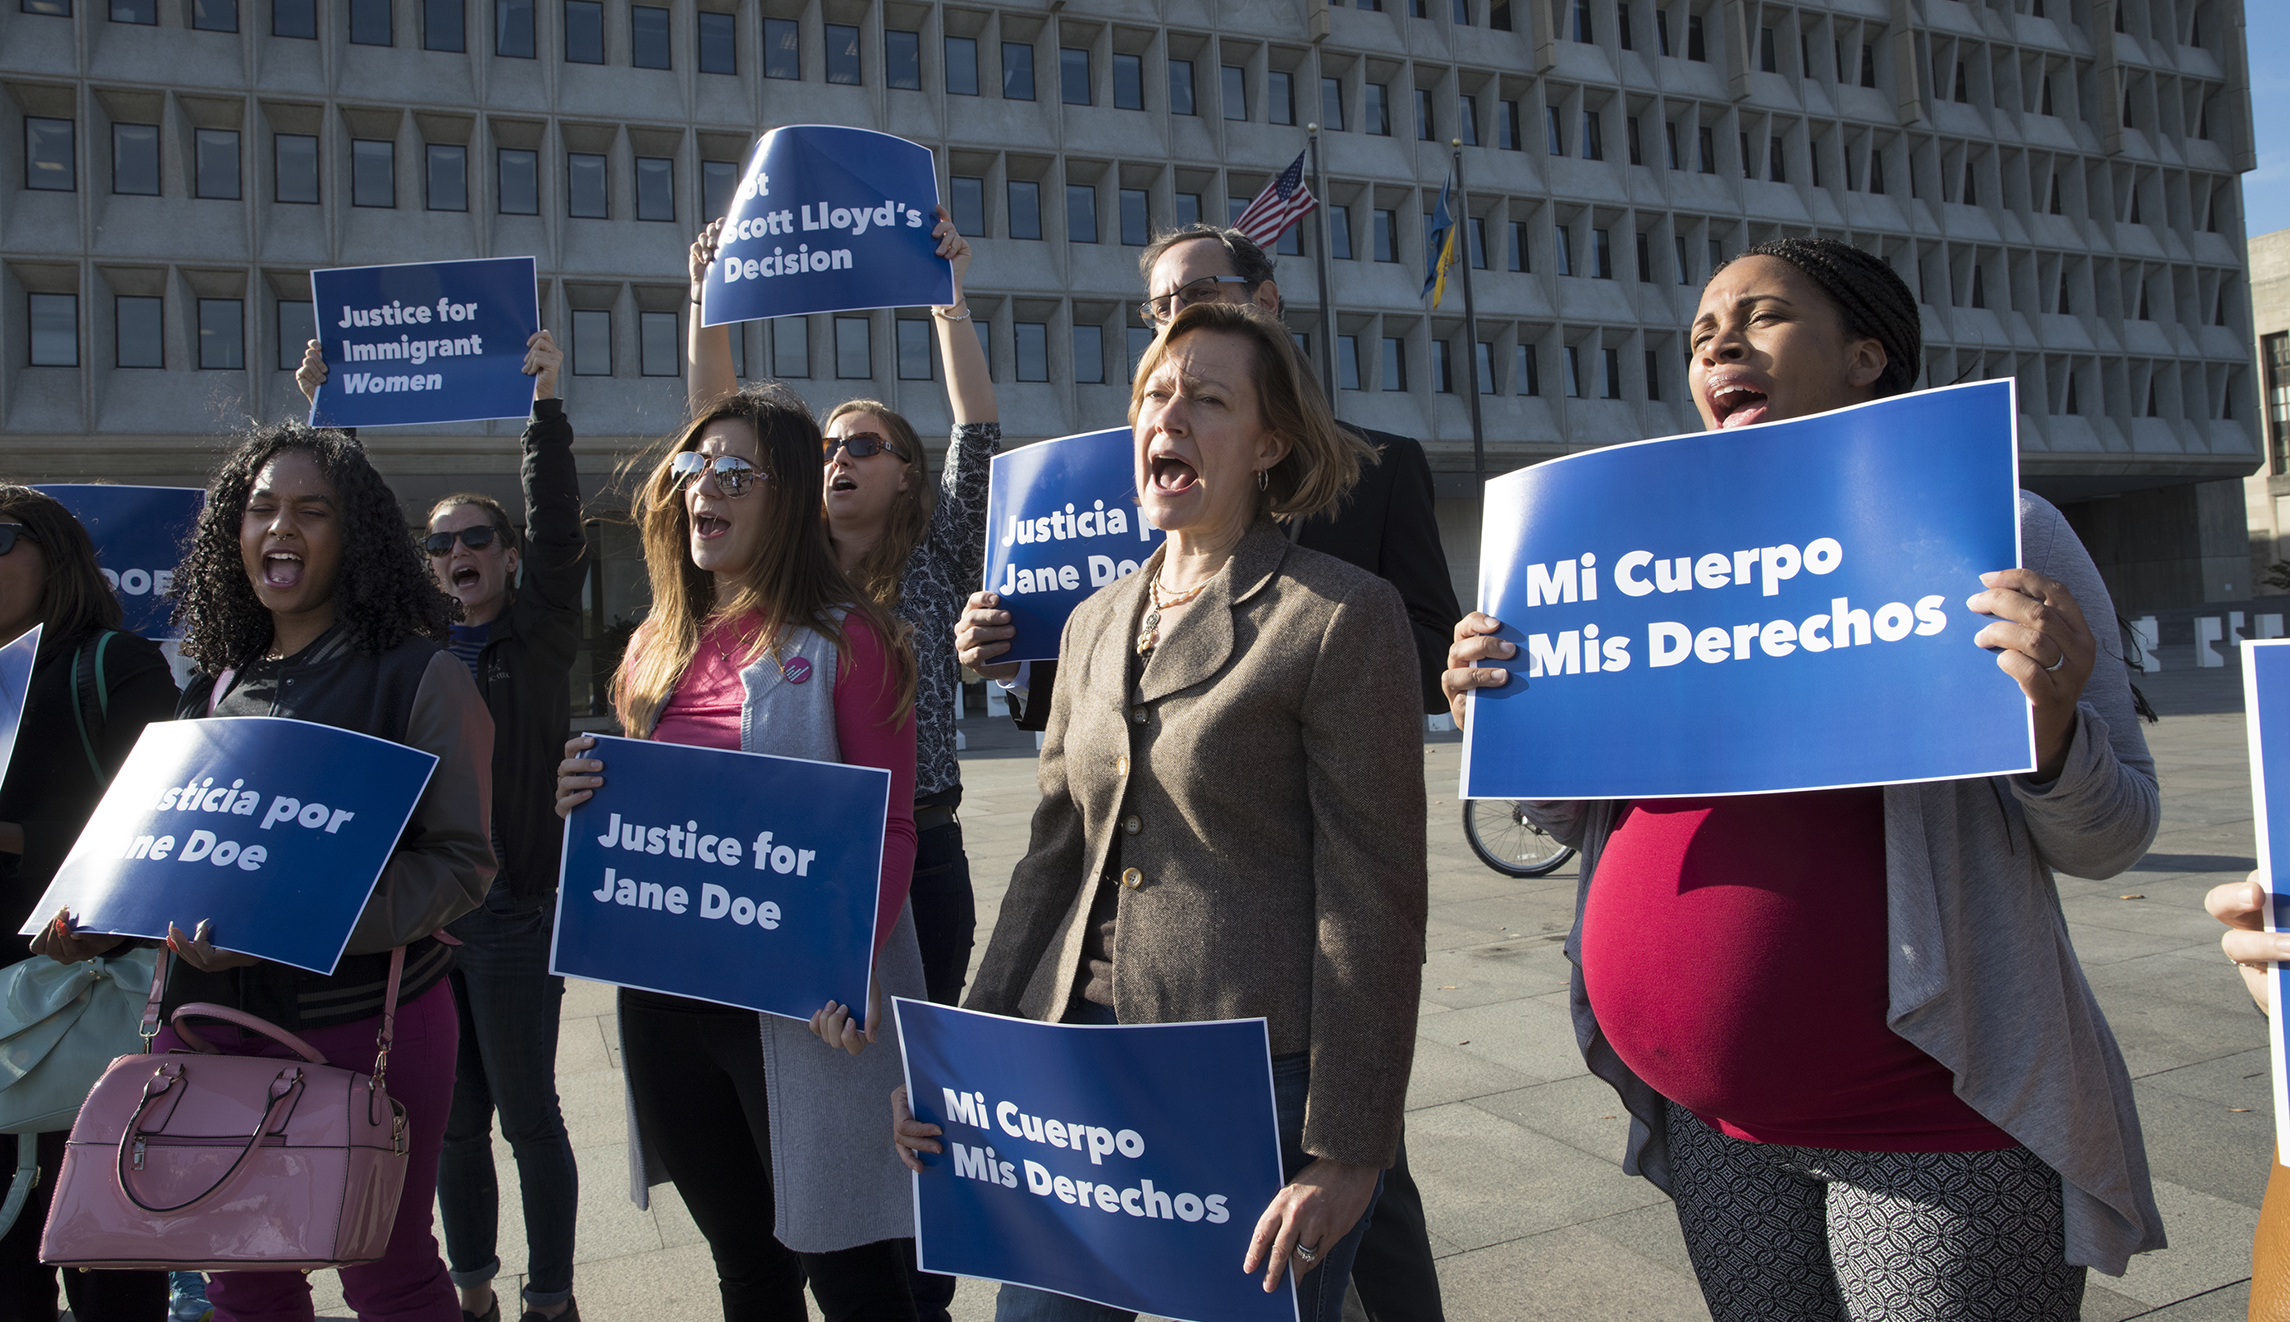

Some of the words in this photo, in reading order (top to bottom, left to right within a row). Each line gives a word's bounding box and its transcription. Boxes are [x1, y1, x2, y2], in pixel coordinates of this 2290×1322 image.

[737, 172, 769, 200] ot
[801, 200, 923, 236] Lloyd's
[724, 243, 853, 284] Decision
[338, 299, 432, 329] Justice
[436, 297, 478, 322] for
[342, 334, 483, 365] Immigrant
[343, 372, 443, 394] Women
[1001, 499, 1128, 547] Justicia
[999, 563, 1080, 596] Jane
[1087, 554, 1150, 588] Do
[1526, 552, 1598, 608] Mi
[1614, 537, 1843, 597] Cuerpo
[1528, 623, 1631, 678] Mis
[1648, 594, 1947, 668] Derechos
[259, 795, 355, 834] por
[177, 829, 268, 871] Doe
[597, 812, 743, 867] Justice
[752, 830, 816, 877] for
[592, 867, 689, 915] Jane
[700, 882, 782, 931] Doe
[942, 1087, 990, 1130] Mi
[996, 1100, 1145, 1165] Cuerpo
[951, 1142, 1019, 1189] Mis
[1023, 1159, 1231, 1224] Derechos
